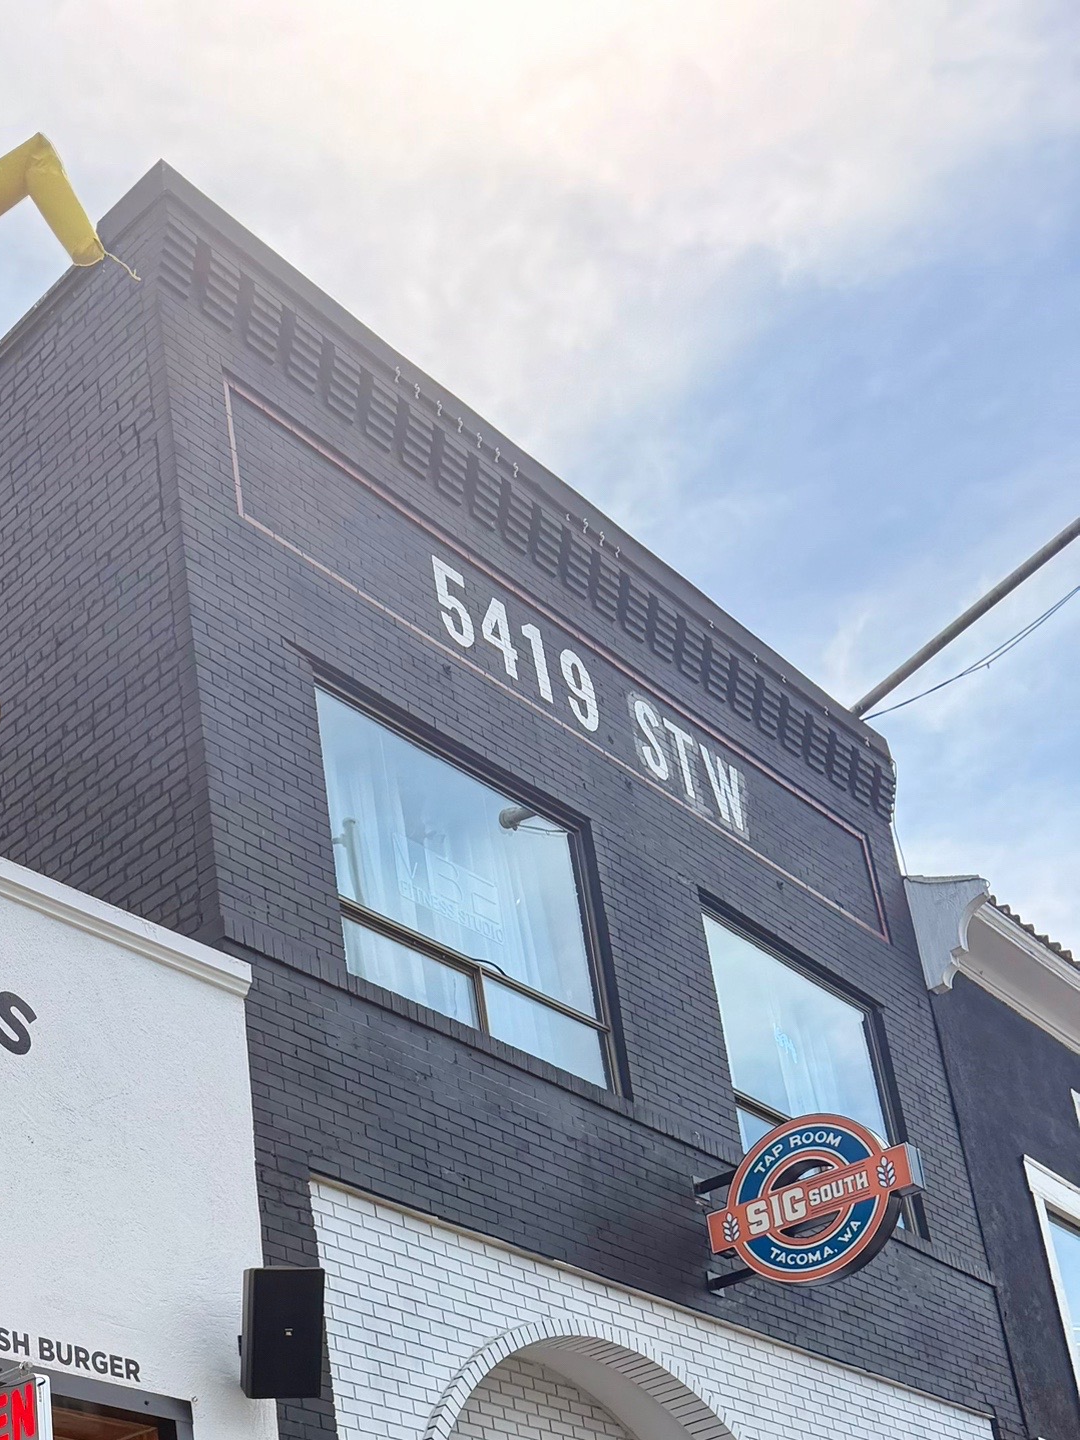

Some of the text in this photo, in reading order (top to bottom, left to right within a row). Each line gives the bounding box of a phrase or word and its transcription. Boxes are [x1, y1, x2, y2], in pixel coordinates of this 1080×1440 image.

[432, 555, 744, 831] 5419 STW
[753, 1131, 842, 1175] TAP ROOM
[746, 1171, 869, 1235] SIG SOUTH
[770, 1219, 861, 1265] TACOMA, WA
[38, 1337, 141, 1383] BURGER
